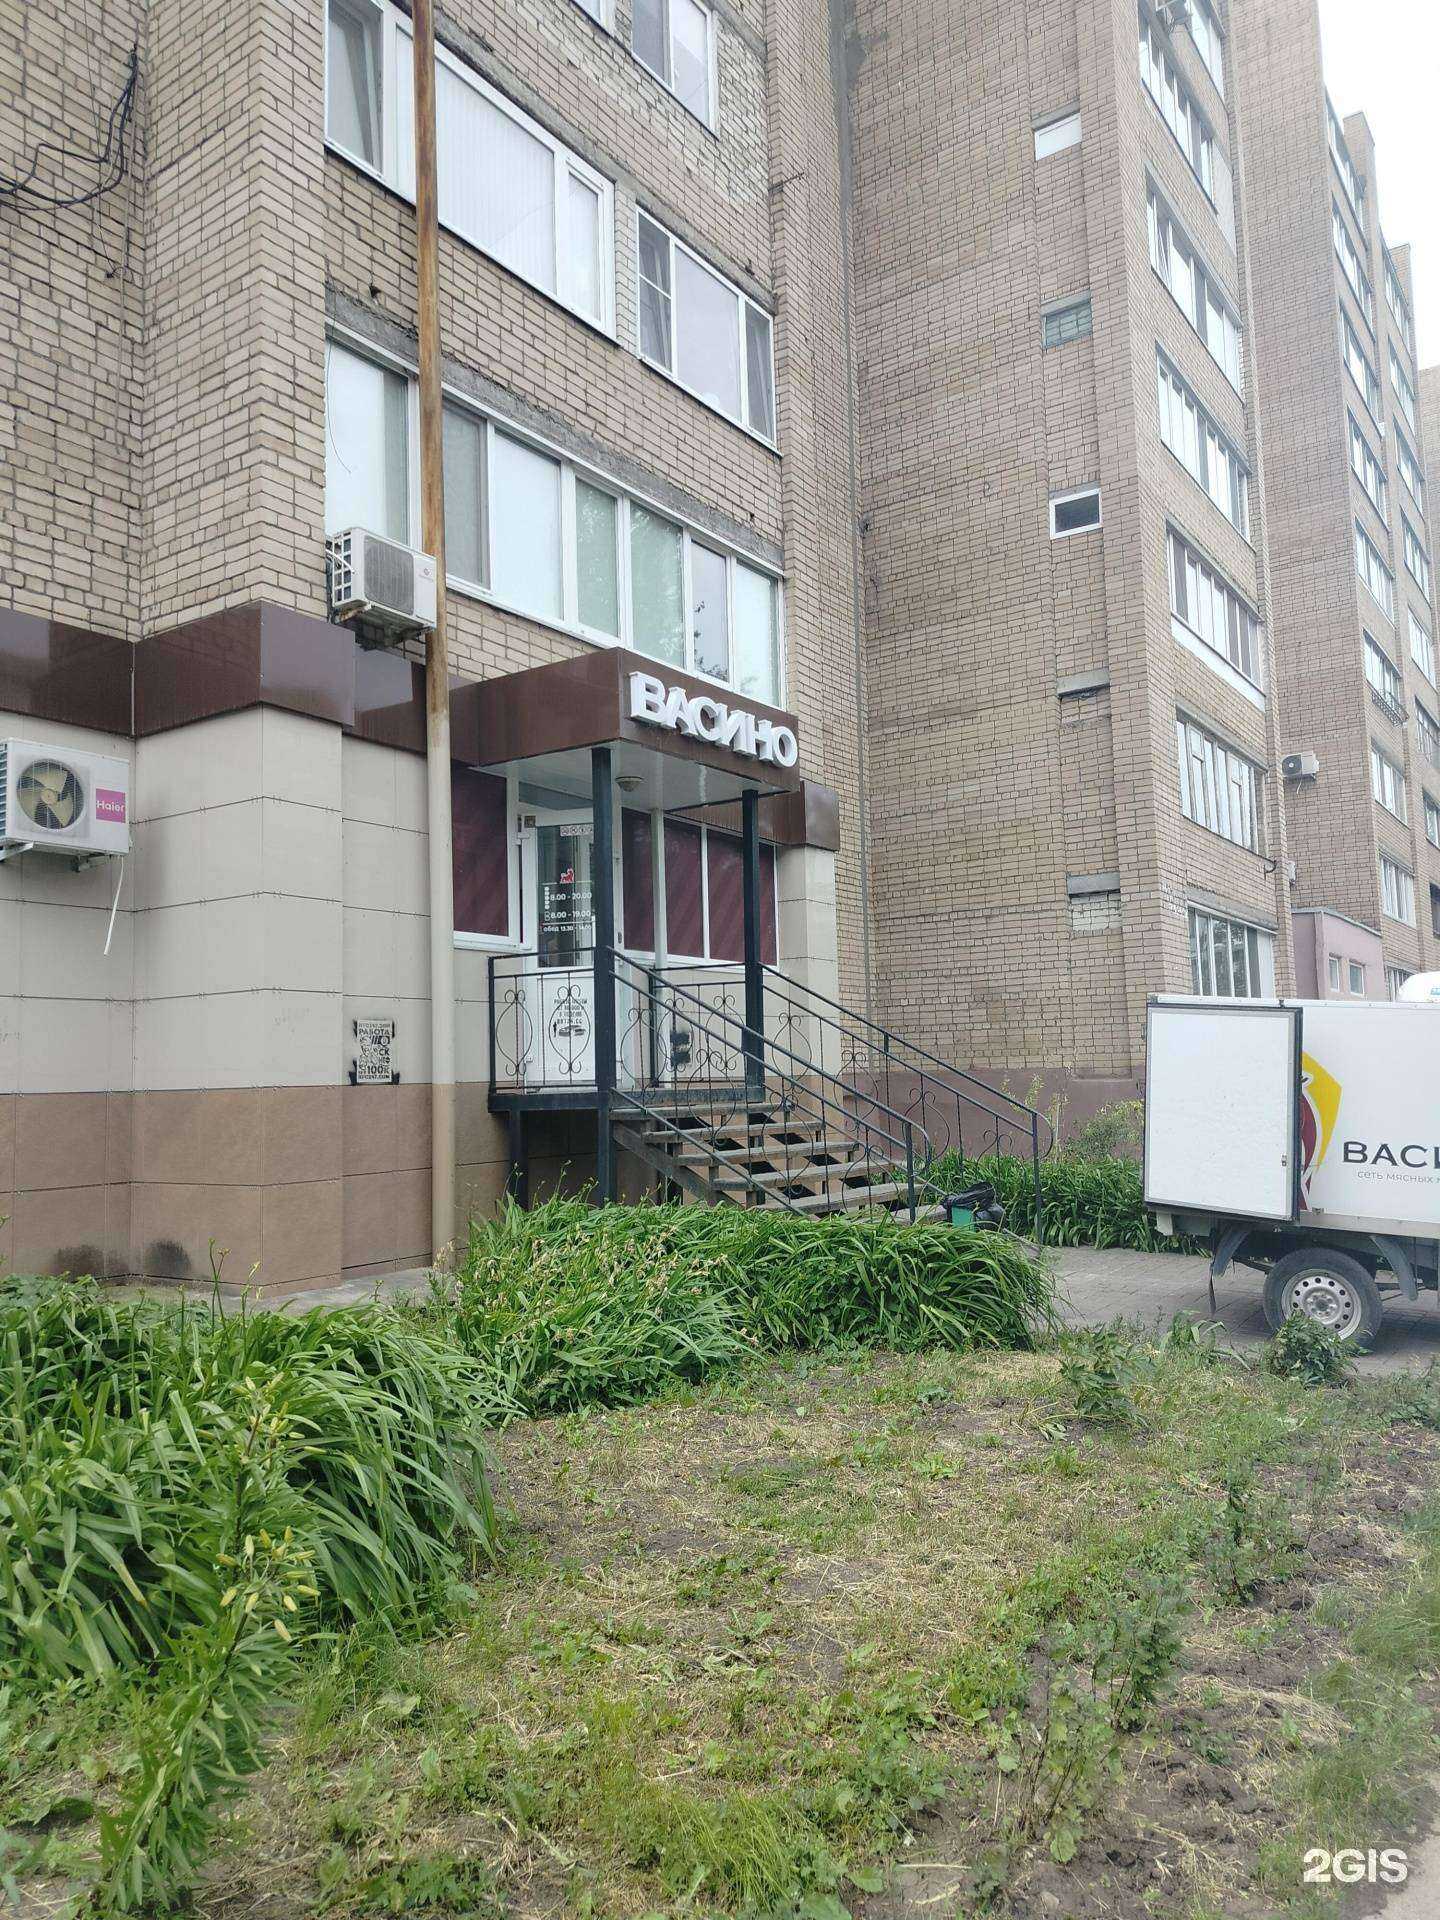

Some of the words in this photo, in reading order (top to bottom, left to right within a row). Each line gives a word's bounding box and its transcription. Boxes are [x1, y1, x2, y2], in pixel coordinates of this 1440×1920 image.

[629, 671, 798, 768] ВАСИНО
[96, 800, 125, 812] Haier
[550, 893, 567, 901] 8.00
[572, 892, 592, 900] 20.00
[550, 911, 567, 919] 8.00
[1357, 1171, 1384, 1180] сеть
[1386, 1174, 1434, 1183] мясных
